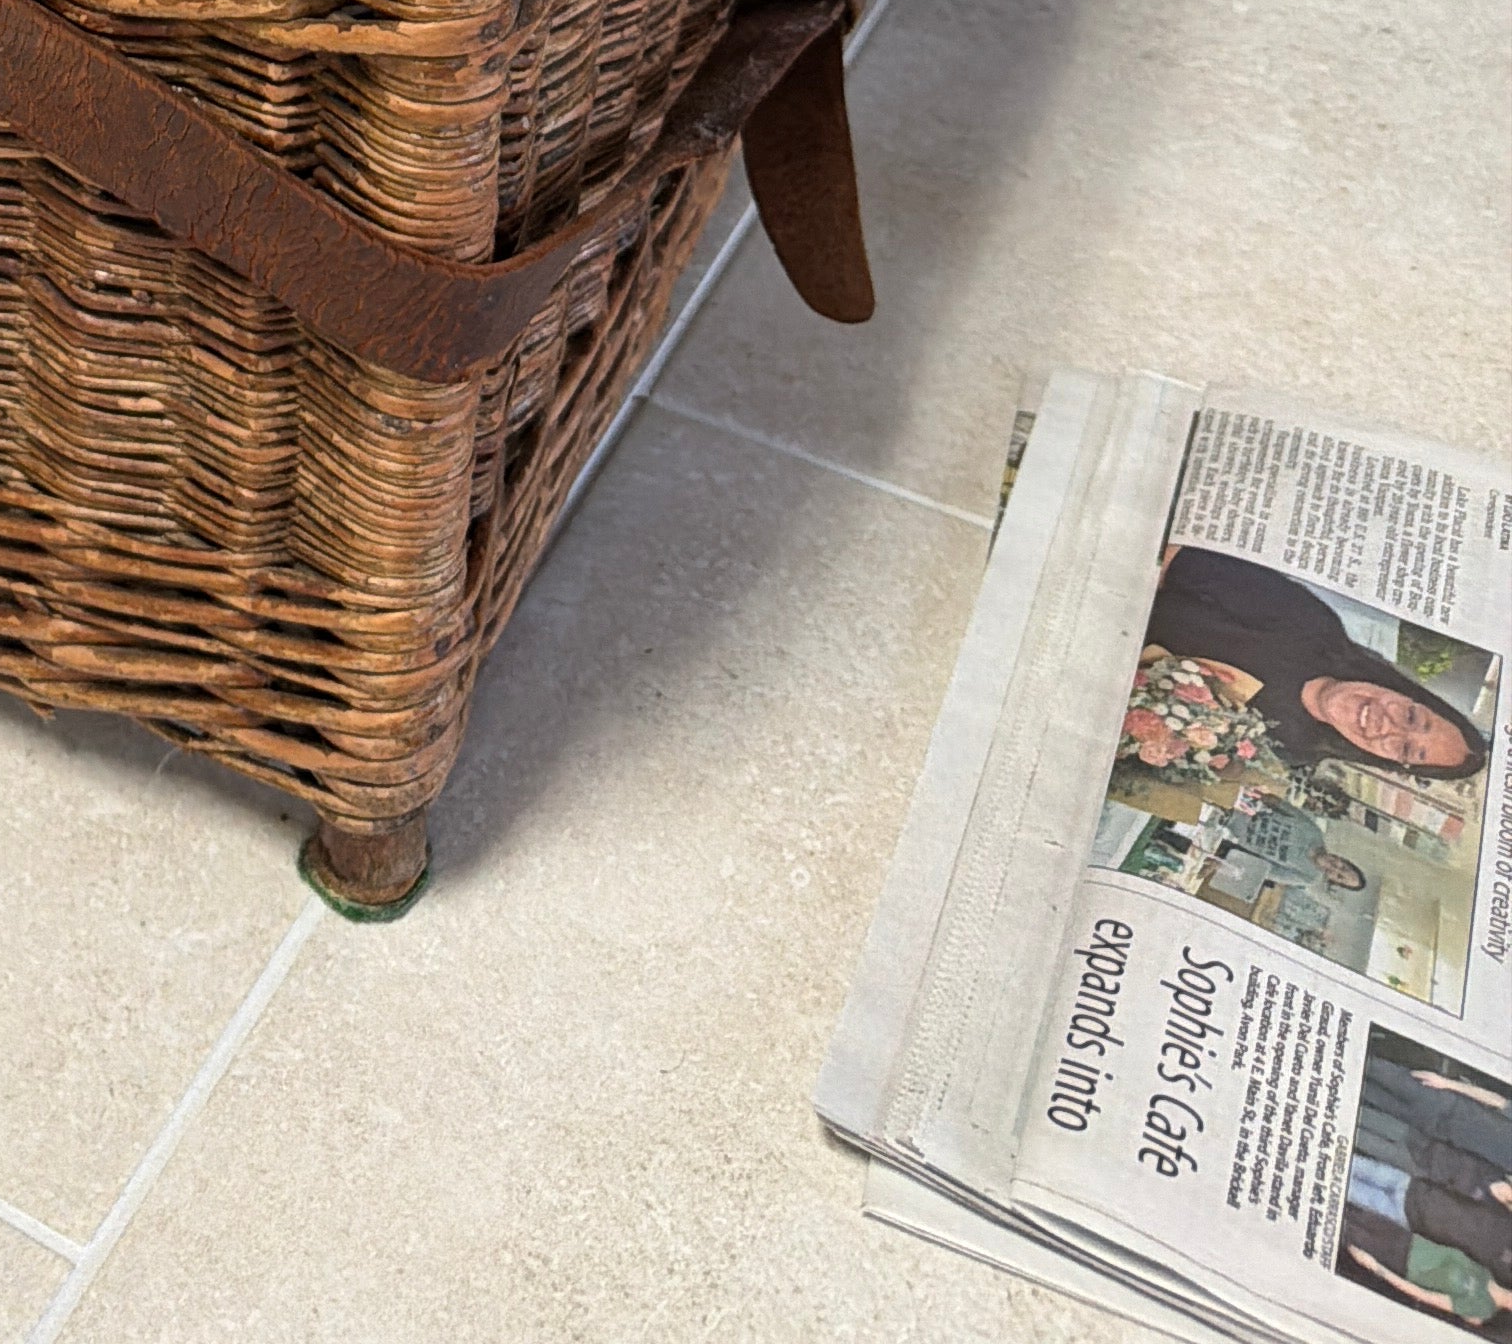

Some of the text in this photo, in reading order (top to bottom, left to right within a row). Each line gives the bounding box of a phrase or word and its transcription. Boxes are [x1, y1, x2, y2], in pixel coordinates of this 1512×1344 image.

[1334, 440, 1349, 468] known
[1347, 445, 1364, 484] business
[1361, 456, 1378, 492] Located
[1392, 479, 1407, 491] by
[1359, 493, 1369, 504] at
[1406, 487, 1421, 499] by
[1455, 486, 1470, 508] Lake
[1304, 513, 1320, 538] floral
[1336, 499, 1354, 533] already
[1420, 503, 1433, 524] with
[1451, 509, 1466, 537] Placid
[1418, 525, 1431, 540] the
[1432, 534, 1446, 557] local
[1449, 538, 1462, 554] has
[1283, 548, 1295, 563] the
[1298, 540, 1314, 569] design
[1327, 536, 1348, 581] becoming
[1398, 538, 1413, 565] flower
[1411, 541, 1426, 577] opening
[1344, 572, 1357, 587] the
[1392, 565, 1408, 587] shop
[1410, 578, 1423, 591] of
[1427, 557, 1443, 595] business
[1442, 563, 1459, 604] beautiful
[1440, 605, 1450, 624] new
[1481, 881, 1512, 965] creativity
[1264, 973, 1280, 998] Cafe
[1257, 997, 1276, 1042] location
[1299, 989, 1316, 1023] Javier
[1046, 917, 1134, 1131] expands into
[1237, 1011, 1254, 1041] Avon
[1296, 1021, 1311, 1044] Del
[1333, 1008, 1352, 1058] Members
[1137, 946, 1234, 1178] Sophie's Cafe
[1254, 1041, 1266, 1056] at
[1290, 1042, 1308, 1076] Cueto
[1311, 1038, 1326, 1074] owner
[1332, 1057, 1346, 1074] of
[1244, 1076, 1262, 1107] Main
[1247, 981, 1299, 1204] front in the opening of the third Sophie's
[1286, 1075, 1300, 1103] and
[1323, 1071, 1344, 1120] Sophie's
[1302, 1105, 1318, 1129] Del
[1238, 1125, 1253, 1140] in
[1234, 1139, 1250, 1162] the
[1314, 1150, 1331, 1181] from
[1268, 1172, 1284, 1210] stand
[1285, 1165, 1305, 1220] manager
[1265, 1206, 1281, 1222] in
[1302, 1206, 1322, 1259] Eduardo
